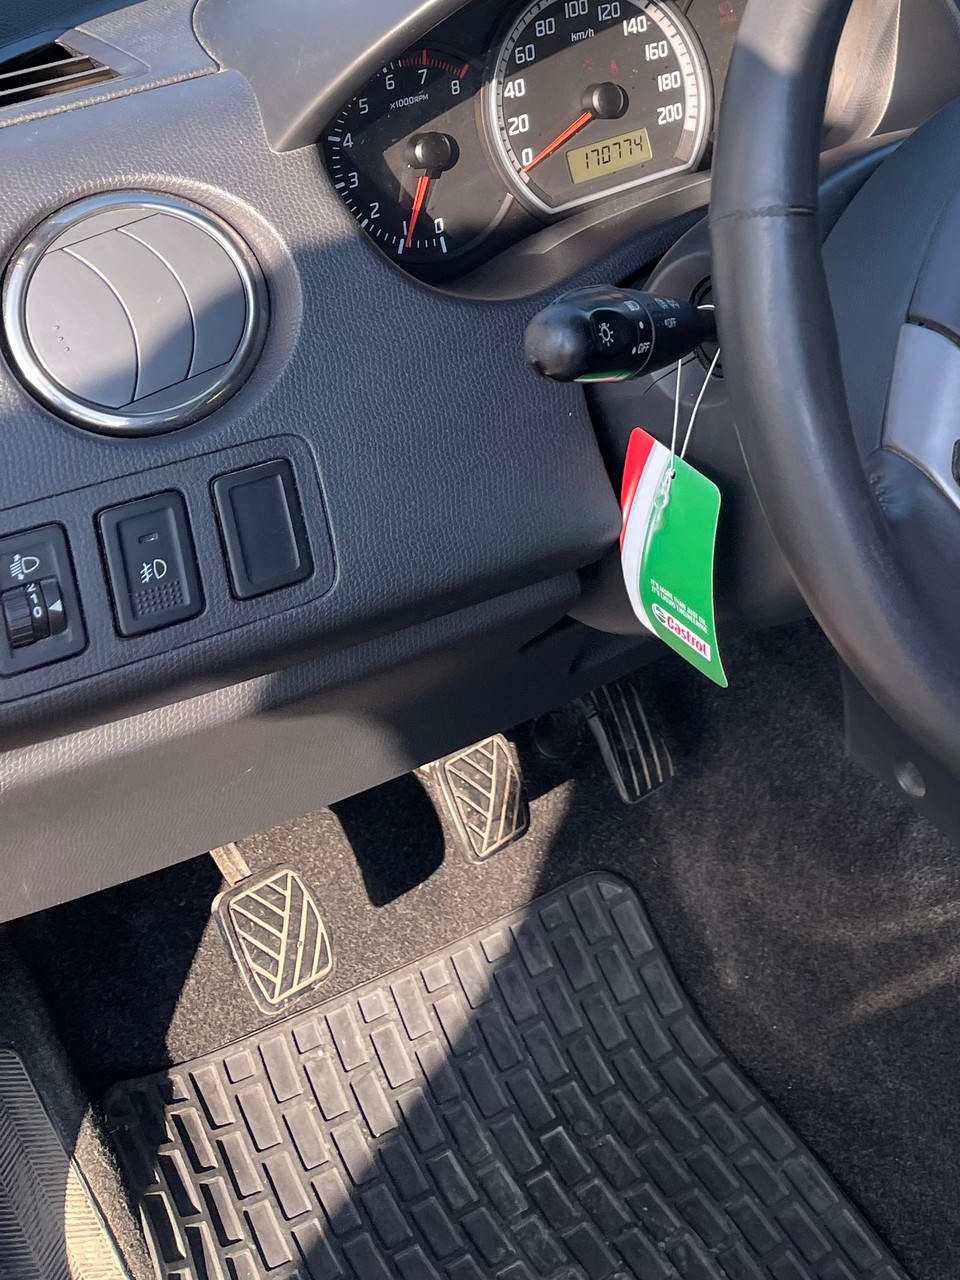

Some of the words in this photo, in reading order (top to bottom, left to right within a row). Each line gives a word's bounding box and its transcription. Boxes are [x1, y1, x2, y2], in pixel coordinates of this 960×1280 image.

[597, 1, 621, 22] 120
[535, 17, 556, 38] 80
[571, 27, 595, 43] km/h
[623, 15, 648, 37] 140
[514, 44, 536, 65] 60
[645, 40, 669, 62] 160
[385, 74, 396, 90] 6
[418, 68, 428, 85] 7
[657, 70, 681, 93] 180
[450, 79, 461, 95] 8
[503, 78, 526, 99] 40
[358, 97, 369, 115] 5
[656, 102, 683, 126] 200
[507, 113, 530, 137] 20
[342, 133, 354, 148] 4
[521, 147, 533, 166] 0
[584, 135, 643, 170] 170774
[348, 171, 359, 188] 3
[369, 202, 380, 219] 2
[402, 220, 408, 236] 1
[434, 217, 444, 234] 0
[637, 341, 651, 354] OFF
[30, 593, 38, 604] 1
[33, 606, 42, 618] 0
[667, 616, 708, 657] Castrol
